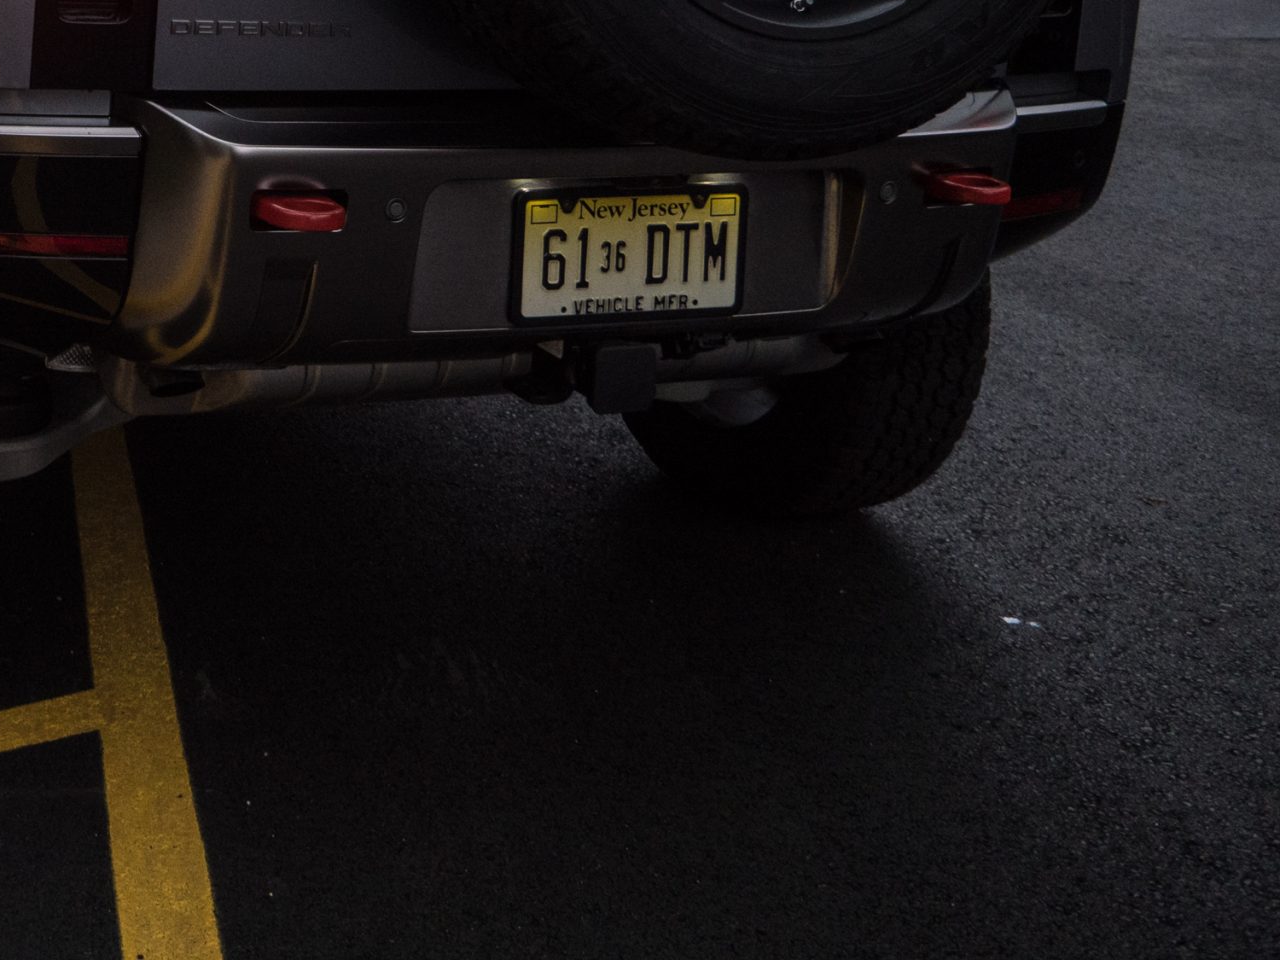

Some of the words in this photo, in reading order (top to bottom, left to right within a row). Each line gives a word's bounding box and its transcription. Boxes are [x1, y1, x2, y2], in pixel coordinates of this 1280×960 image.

[171, 19, 353, 38] DEFENDER
[578, 199, 626, 220] New
[628, 197, 690, 222] Jersey
[542, 227, 589, 290] 61
[600, 240, 627, 274] 36
[645, 221, 728, 284] DTM
[573, 296, 644, 315] VEHICLE
[653, 294, 688, 311] MFR
